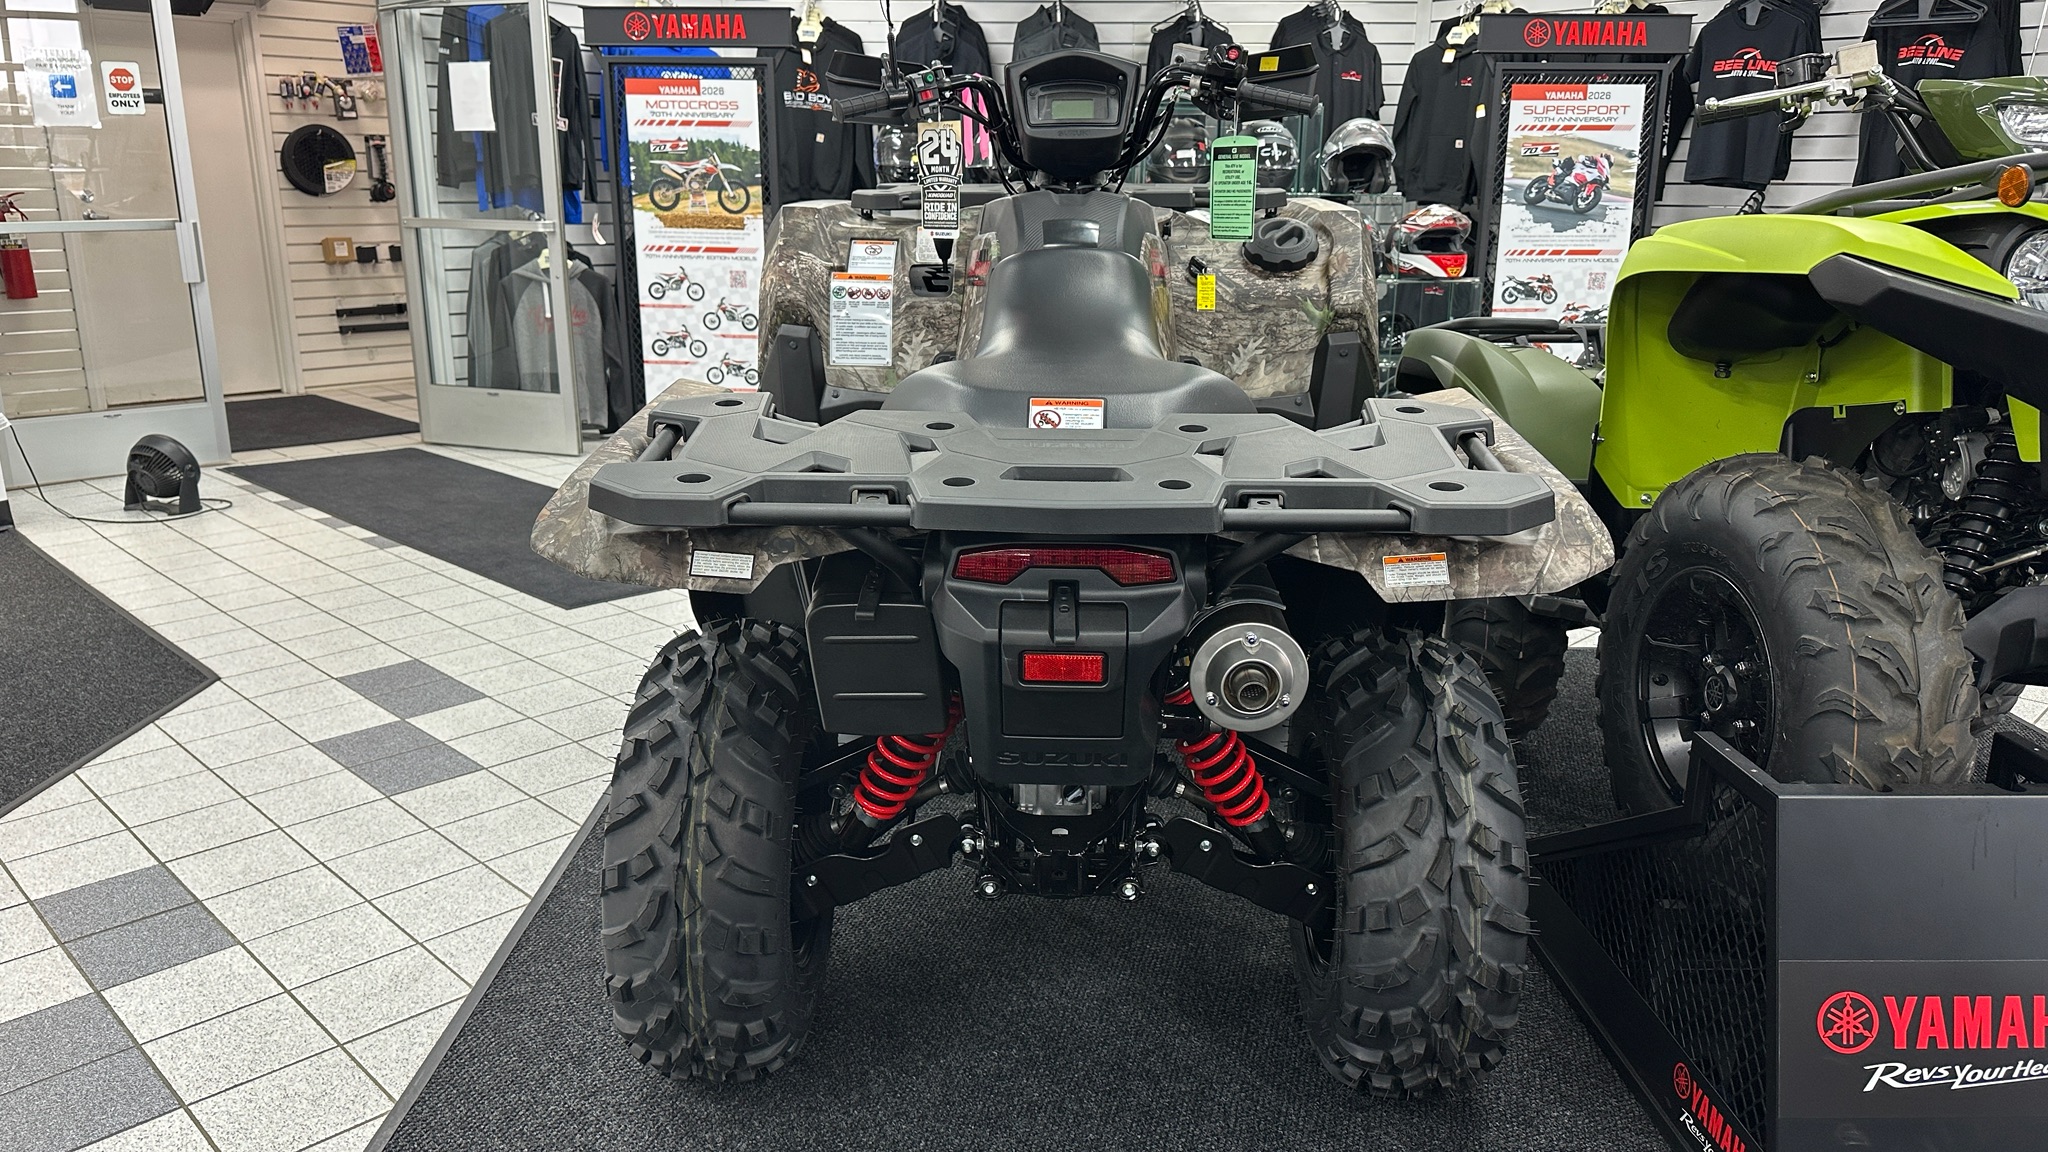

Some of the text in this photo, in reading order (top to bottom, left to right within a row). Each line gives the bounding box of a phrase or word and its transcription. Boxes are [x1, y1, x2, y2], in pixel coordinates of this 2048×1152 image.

[651, 13, 747, 40] YAMAHA
[1553, 20, 1648, 47] YAMAHA
[1897, 46, 1965, 61] BEE LINE
[1713, 59, 1777, 72] BEE LINE
[110, 76, 134, 84] STOP
[658, 86, 698, 95] YAMAHA
[784, 90, 805, 101] BAD
[1545, 91, 1612, 100] YAMAHA 2026
[646, 100, 739, 110] MOTOCROSS
[1522, 105, 1631, 115] SUPERSPORT
[922, 129, 958, 165] 24
[924, 202, 957, 212] RIDE IN
[924, 212, 957, 220] CONFIDENCE
[997, 752, 1129, 768] SUZUKI
[1862, 1062, 1952, 1092] Revs
[1951, 1064, 2014, 1090] Your
